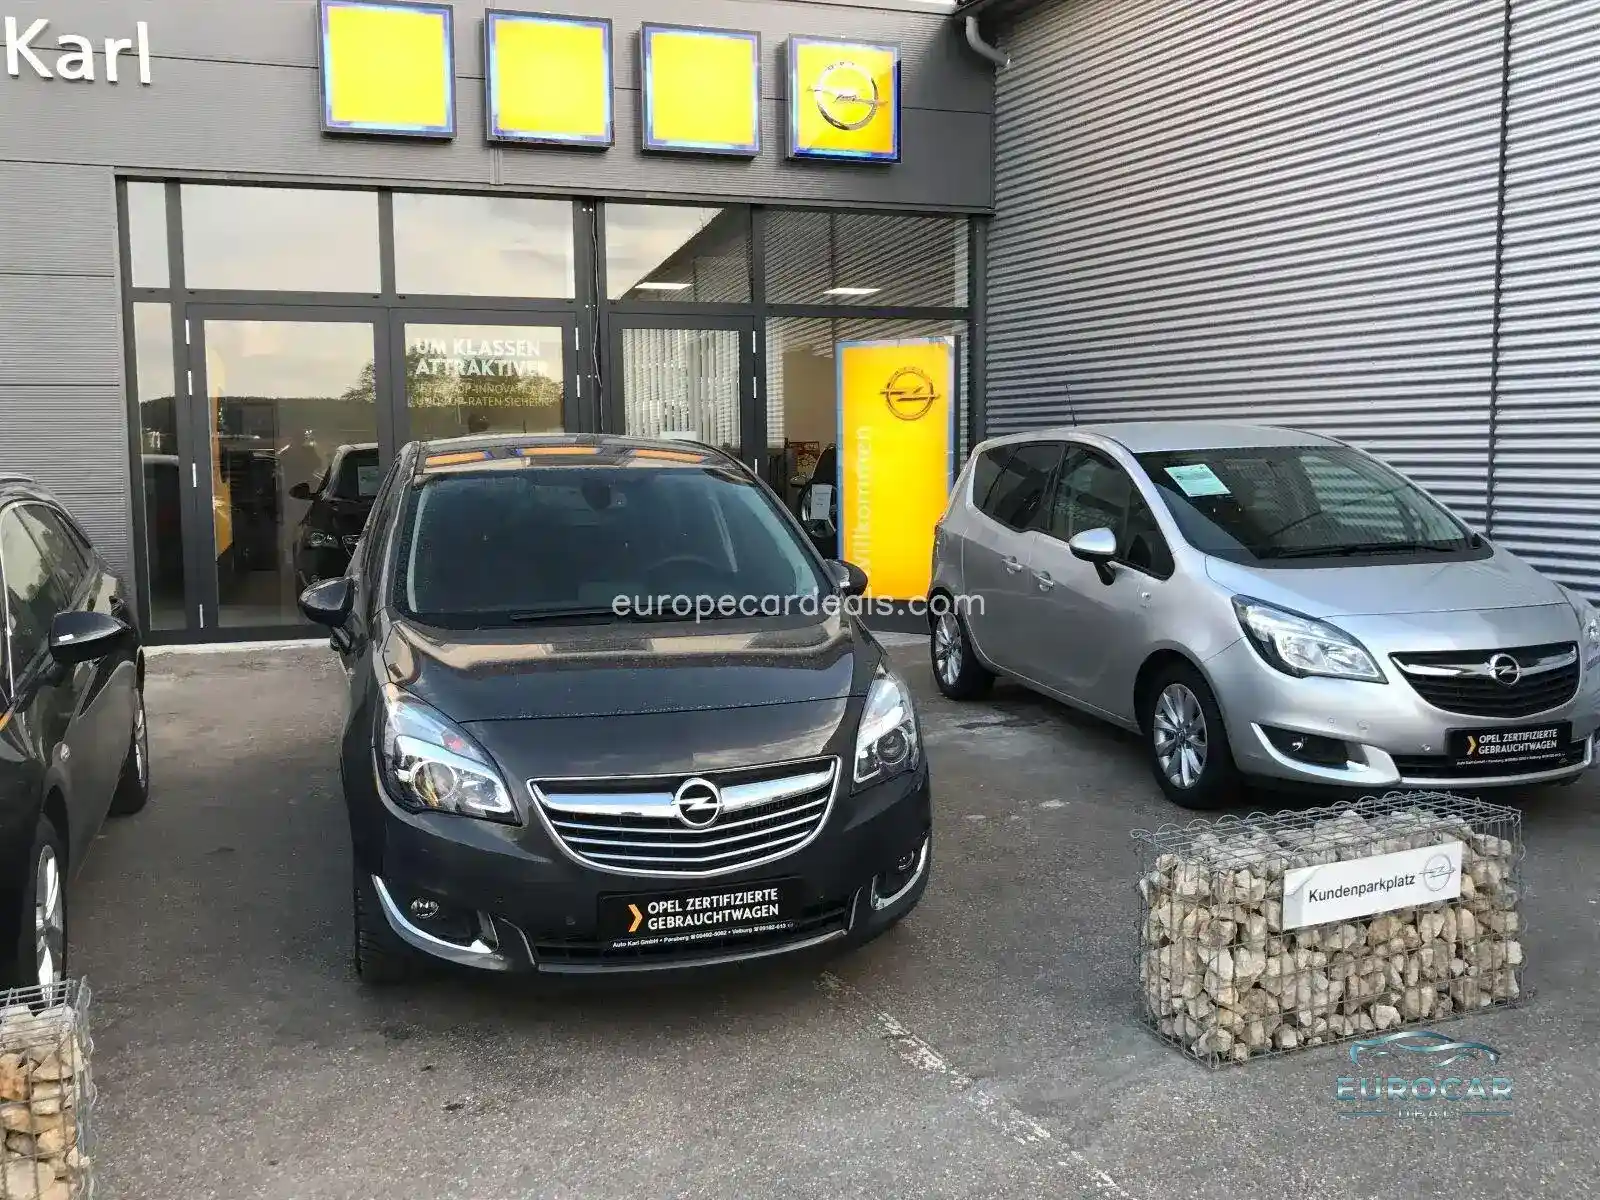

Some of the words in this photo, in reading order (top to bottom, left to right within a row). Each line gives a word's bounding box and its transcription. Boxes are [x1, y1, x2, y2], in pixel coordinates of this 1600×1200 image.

[4, 16, 151, 85] Karl
[415, 338, 447, 355] UM
[453, 338, 541, 357] KLASSEN
[415, 357, 549, 377] ATTRAKTIVER
[1479, 733, 1501, 744] OPEL
[1502, 728, 1558, 743] ZERTIFIZIERTE
[1478, 740, 1557, 755] GEBRAUCHTWAGEN
[1308, 873, 1416, 903] Kundenparkplatz
[647, 900, 683, 915] OPEL
[686, 888, 779, 911] ZERTIFIZIERTE
[647, 904, 780, 931] GEBRAUCHTWAGEN
[640, 938, 659, 946] GmbH
